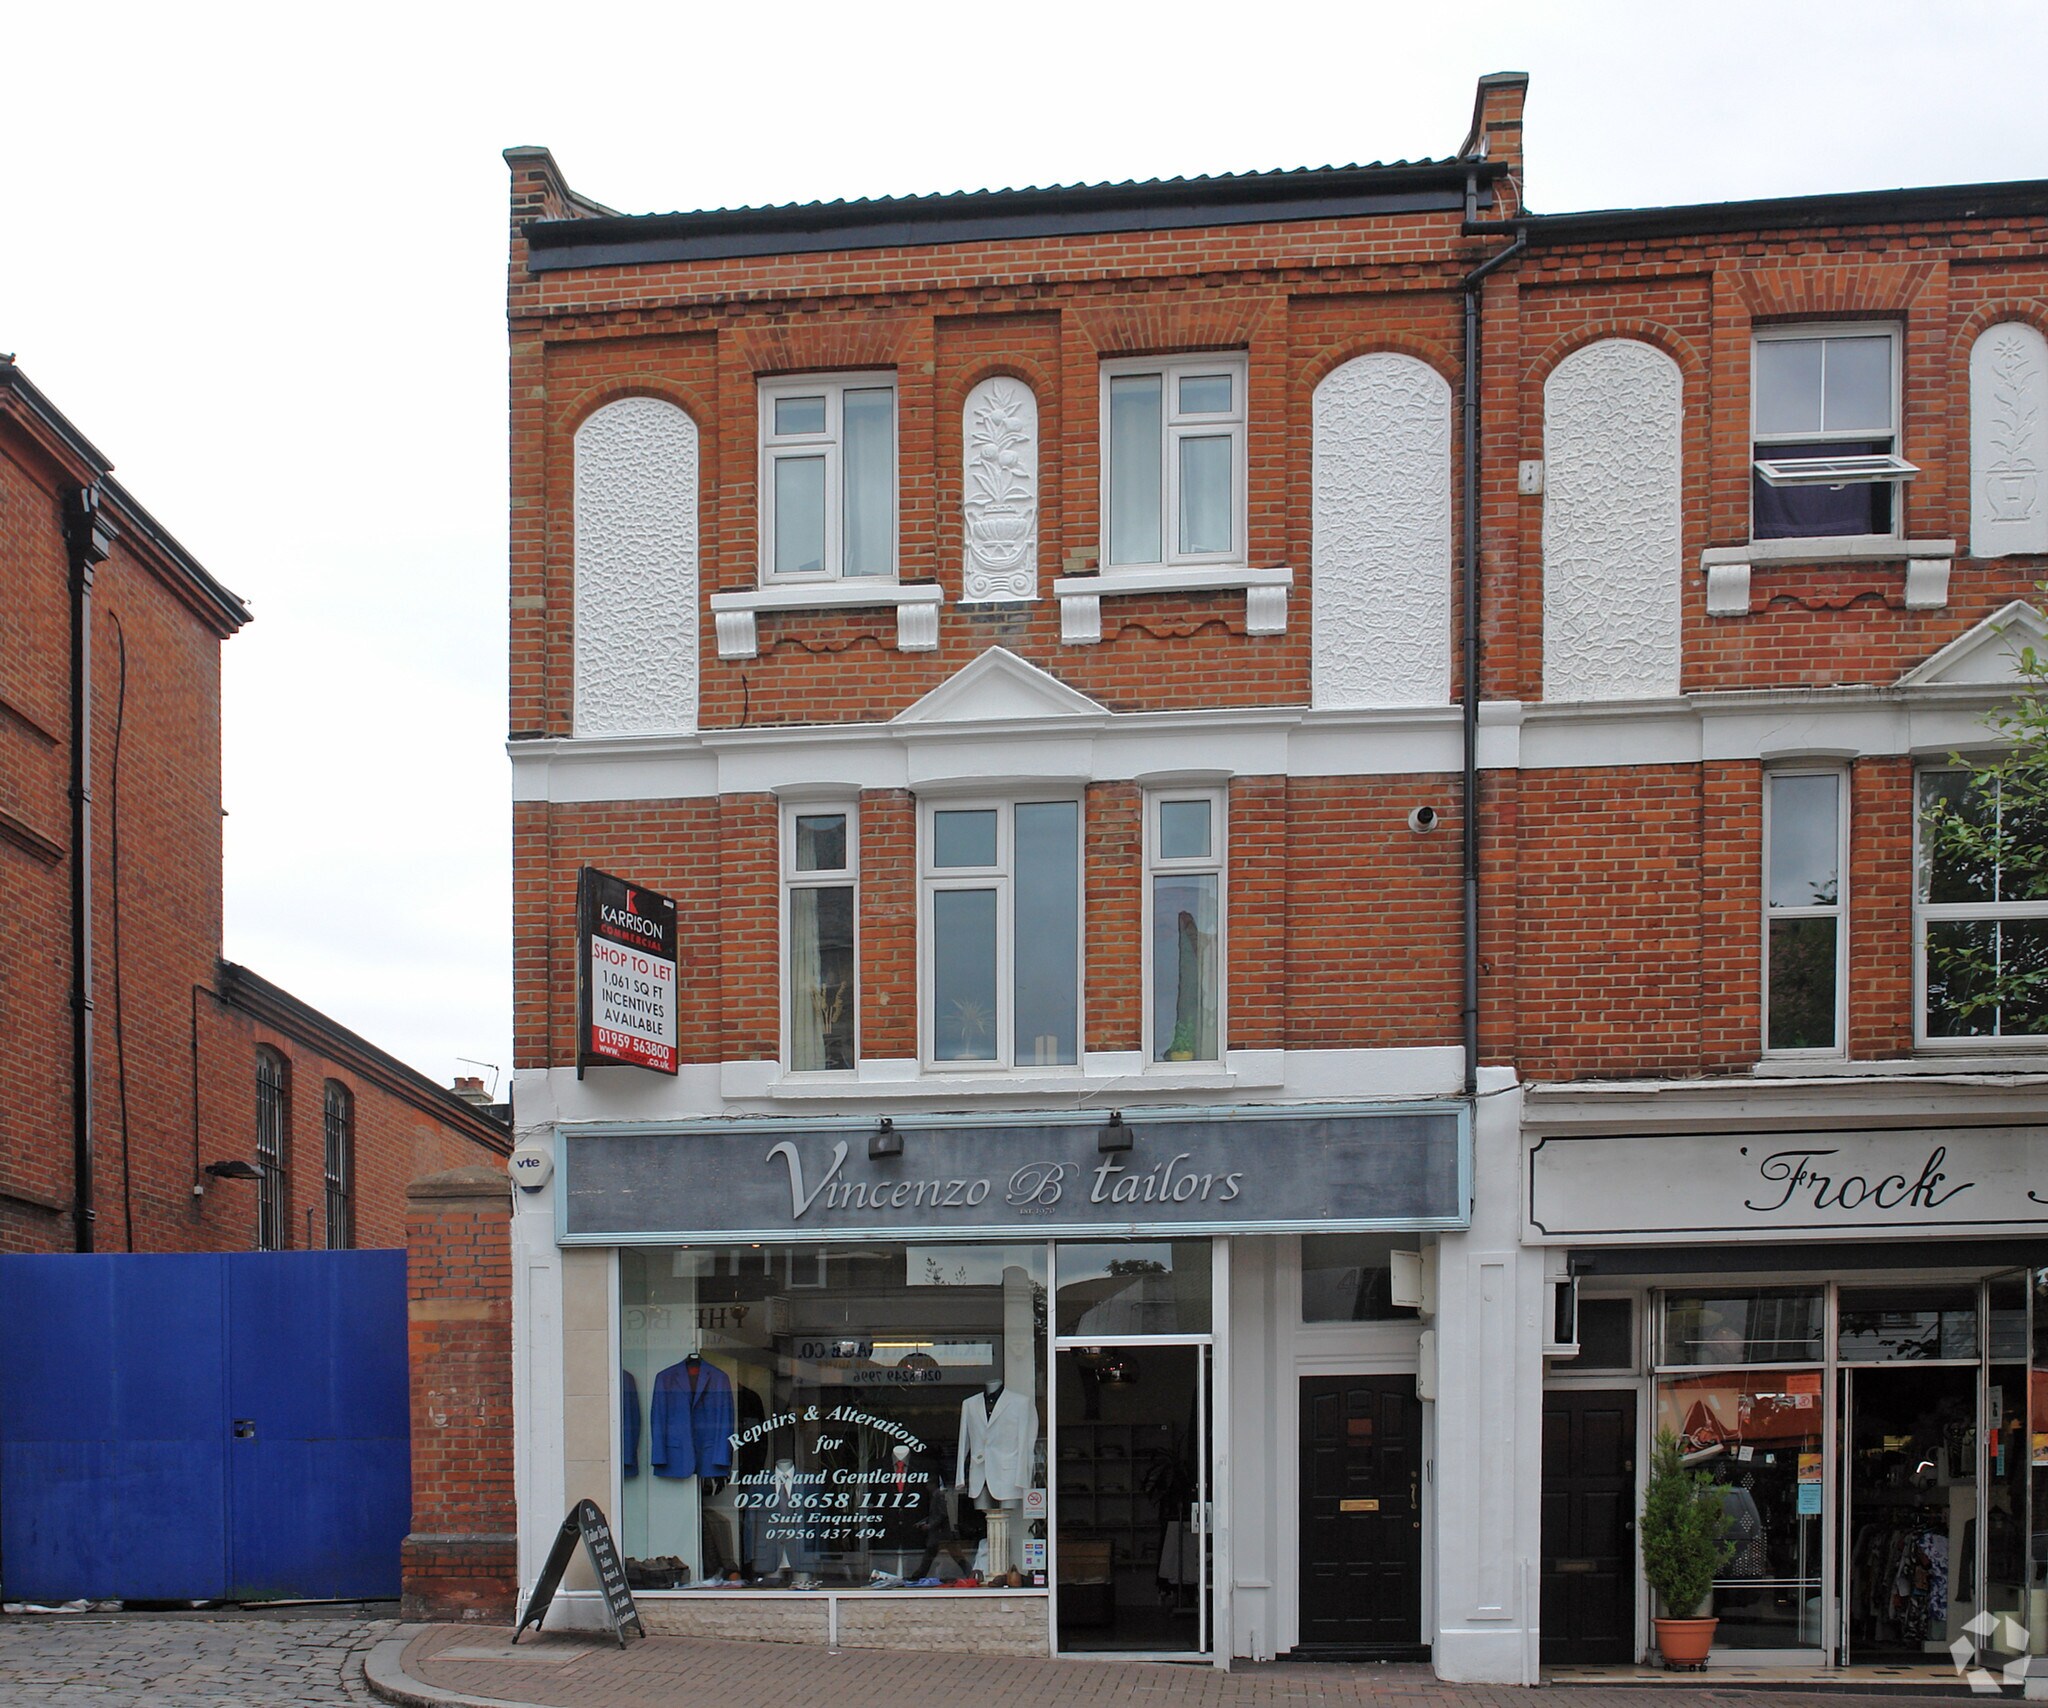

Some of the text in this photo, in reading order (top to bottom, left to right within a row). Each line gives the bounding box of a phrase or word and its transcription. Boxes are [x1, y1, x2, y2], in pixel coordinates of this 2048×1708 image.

[601, 904, 663, 939] KARRISON
[601, 924, 662, 951] COMMERCIAL
[594, 943, 671, 981] SHOP TO LET
[603, 971, 663, 999] 1,061 SQ FT
[602, 988, 664, 1017] INCENTIVES
[604, 1008, 663, 1035] AVAILABLE
[599, 1028, 669, 1059] 01959 563800
[517, 1157, 540, 1168] vte
[765, 1140, 1243, 1219] Vincenzo B tailors
[727, 1405, 927, 1454] Repairs & Alterations
[812, 1435, 843, 1454] for
[728, 1468, 929, 1485] Ladies and Gentlemen
[733, 1492, 921, 1508] 020 8658 1112
[768, 1512, 883, 1525] Suit Enquires
[765, 1528, 886, 1539] 07956 437 494
